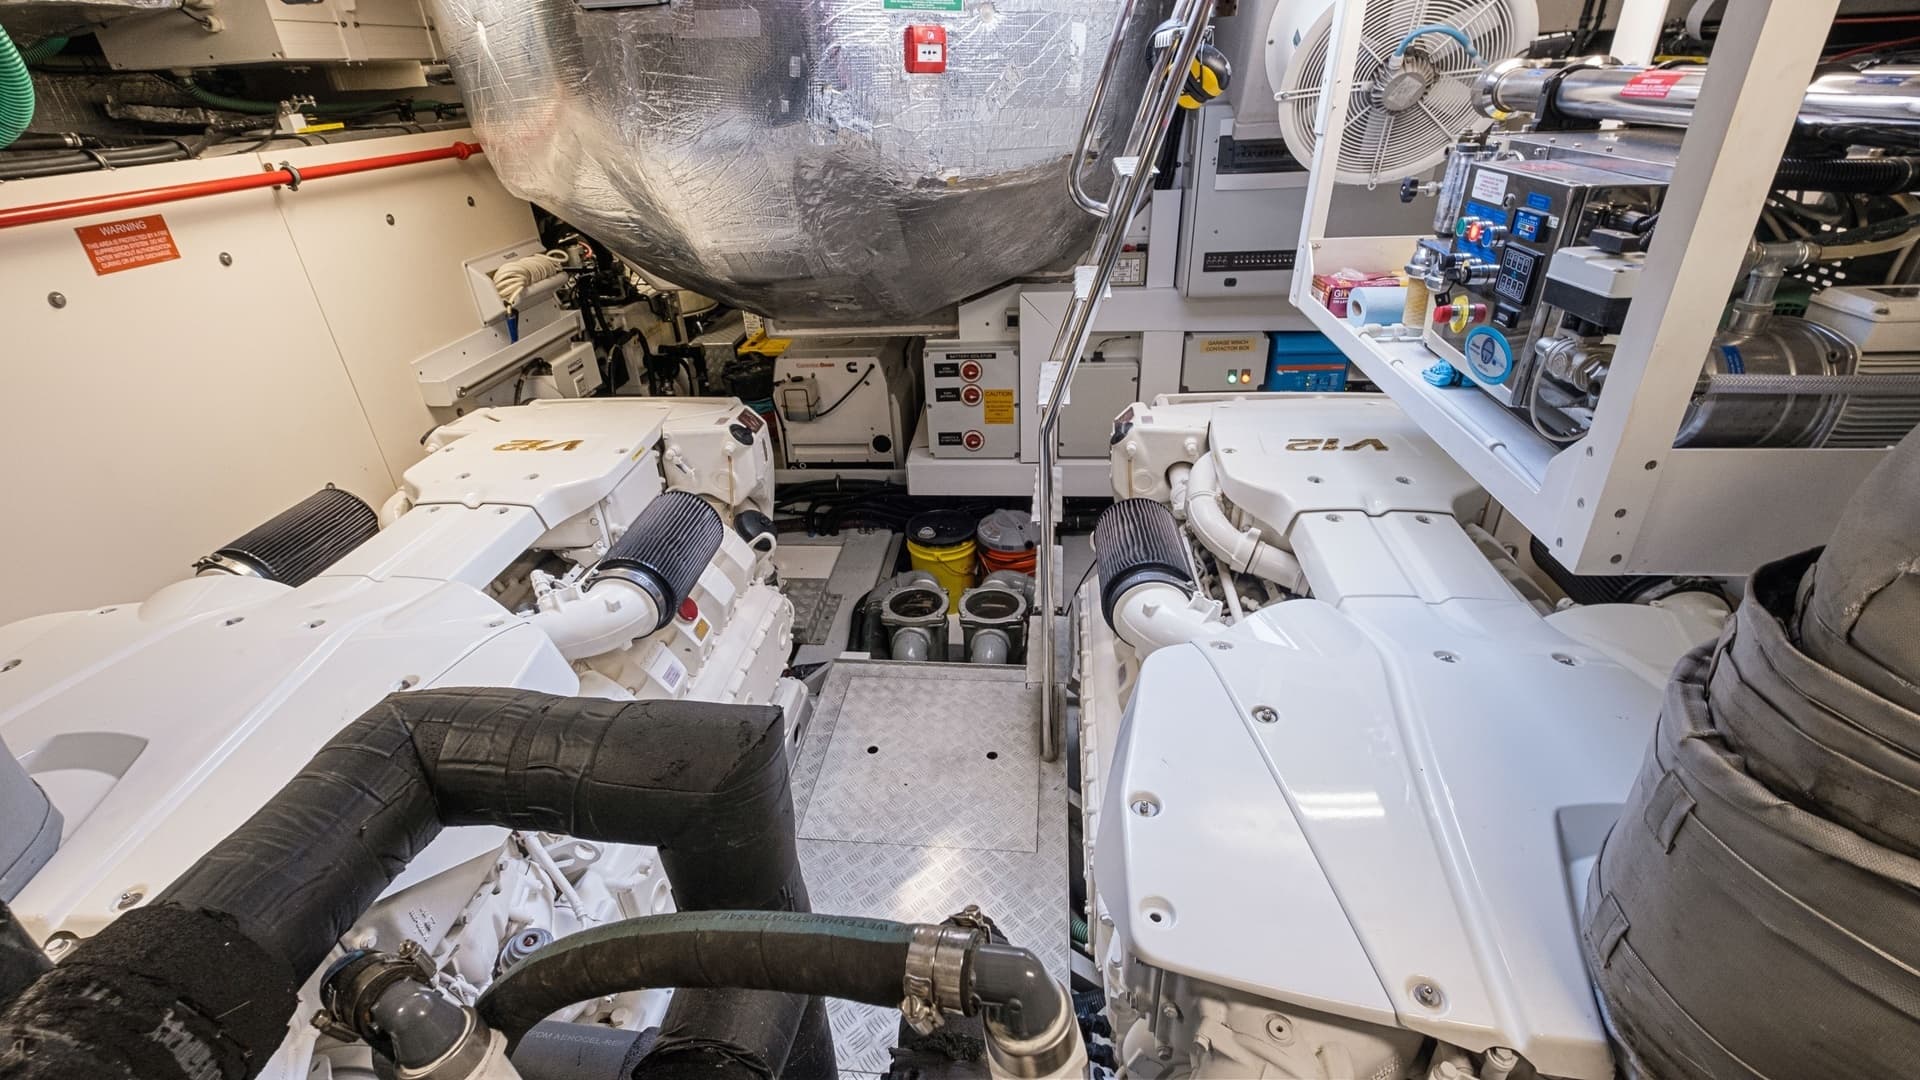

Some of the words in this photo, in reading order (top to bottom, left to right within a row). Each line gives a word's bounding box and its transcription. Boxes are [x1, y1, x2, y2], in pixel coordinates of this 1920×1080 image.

[99, 221, 147, 236] WARNING
[492, 439, 585, 451] V12
[1285, 438, 1389, 451] V12
